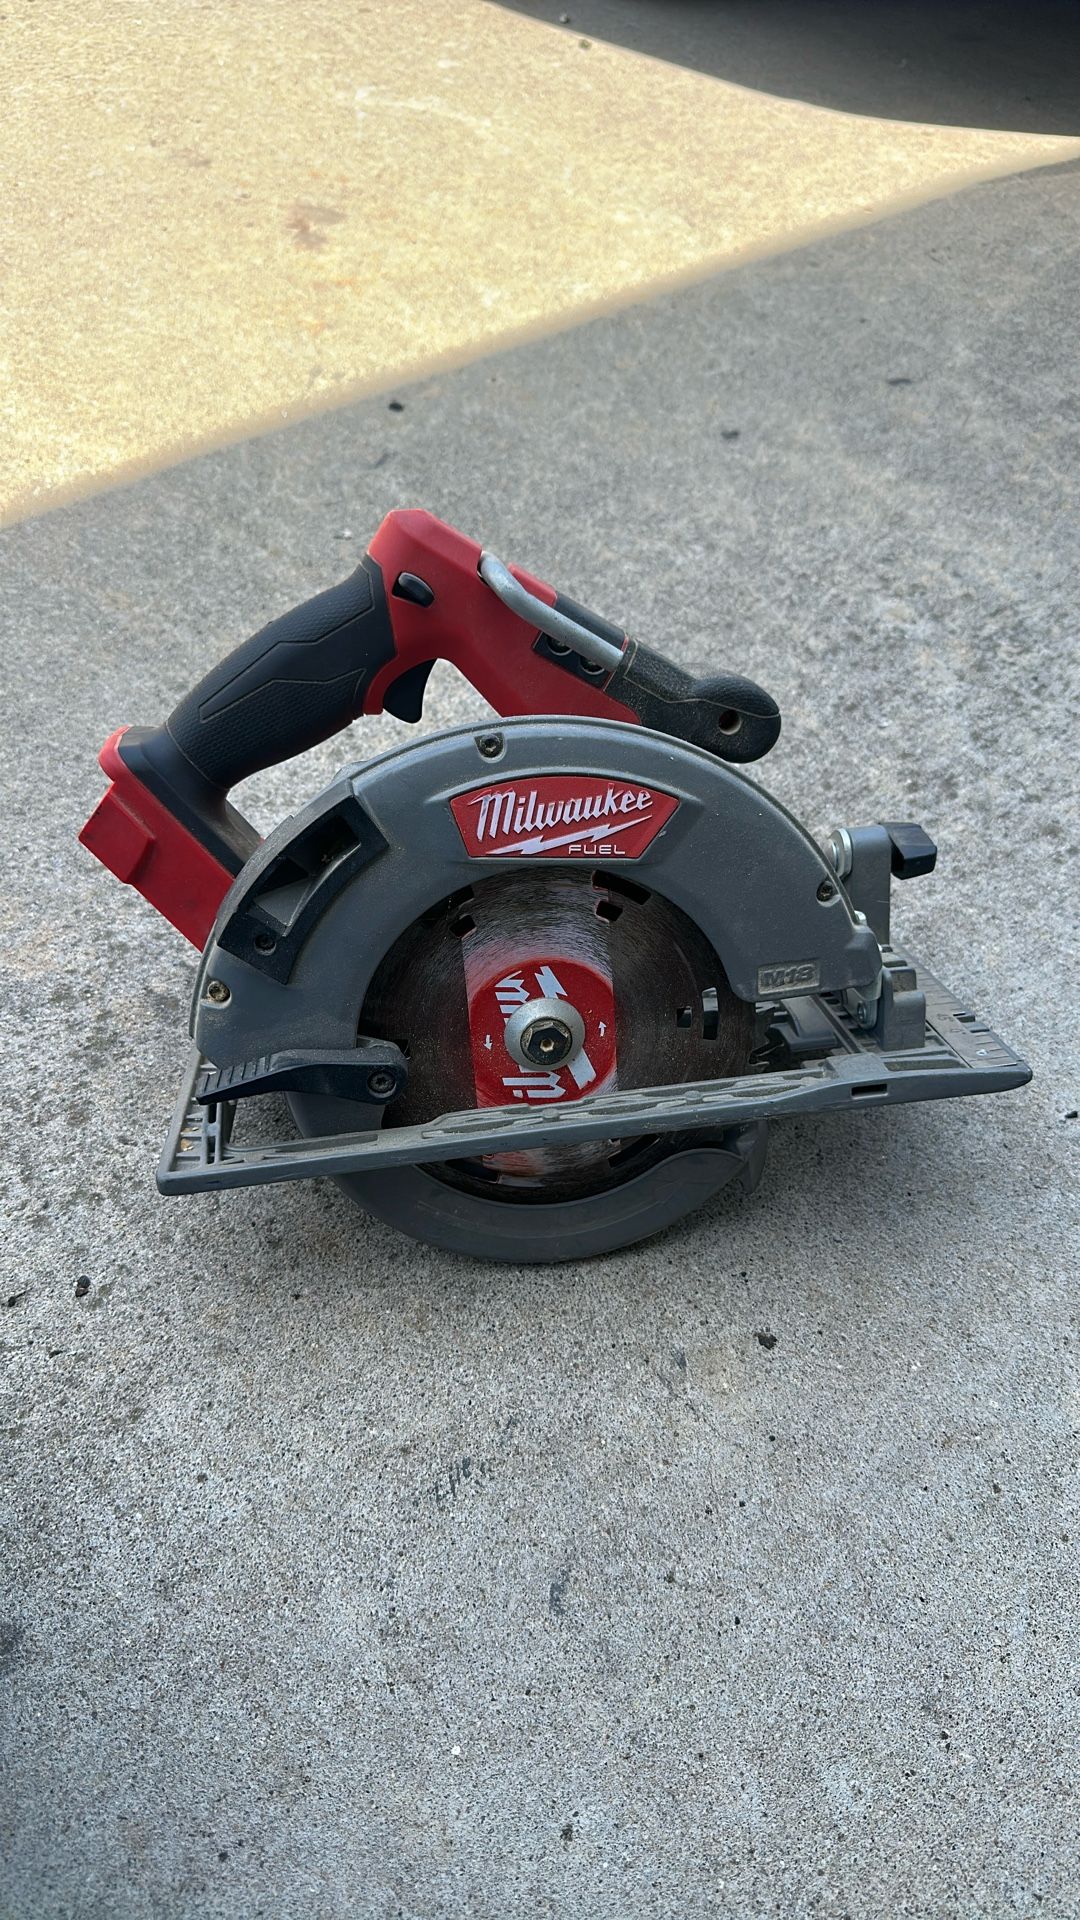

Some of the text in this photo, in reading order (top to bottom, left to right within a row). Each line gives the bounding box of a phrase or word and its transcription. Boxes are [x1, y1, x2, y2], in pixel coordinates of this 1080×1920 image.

[468, 783, 654, 841] Milwaukee
[567, 844, 626, 855] FUEL
[761, 964, 814, 987] M18
